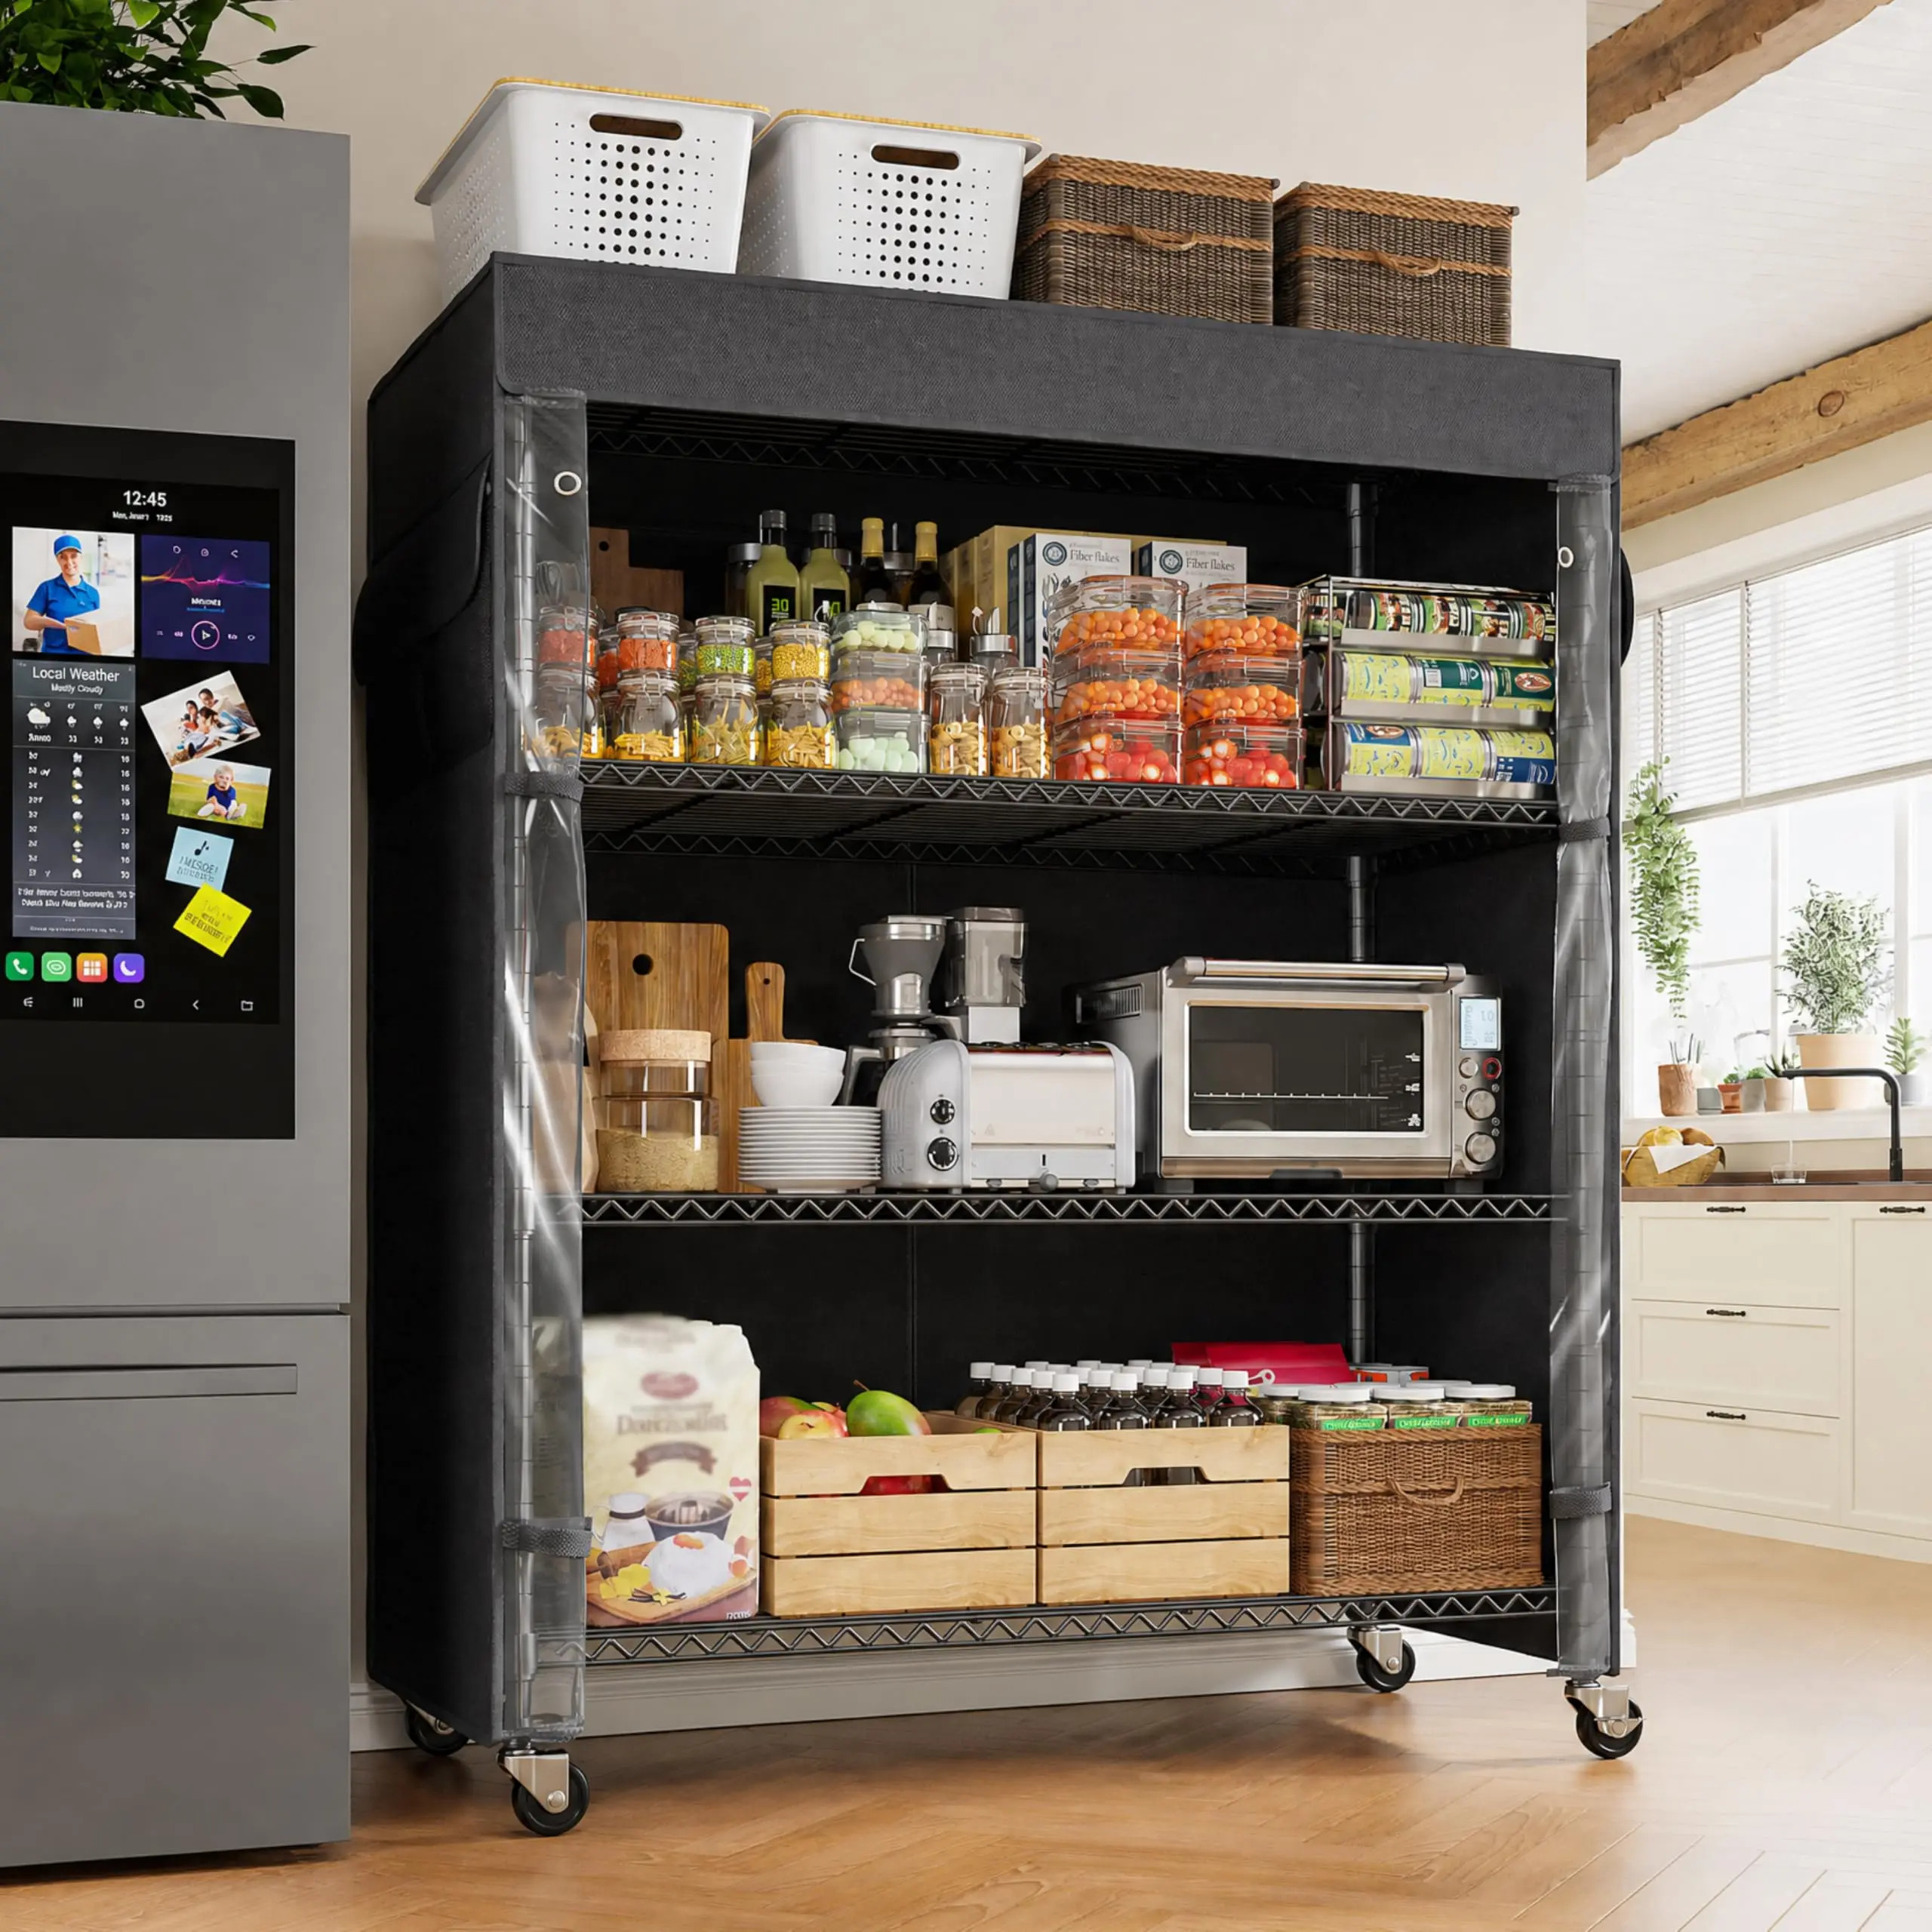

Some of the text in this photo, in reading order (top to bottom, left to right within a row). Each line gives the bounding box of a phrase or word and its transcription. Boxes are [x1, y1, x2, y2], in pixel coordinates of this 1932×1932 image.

[123, 490, 167, 507] 12:45
[1070, 549, 1120, 563] Fiber flakes
[1186, 557, 1235, 571] Fiber flakes
[32, 666, 120, 682] Local Weather
